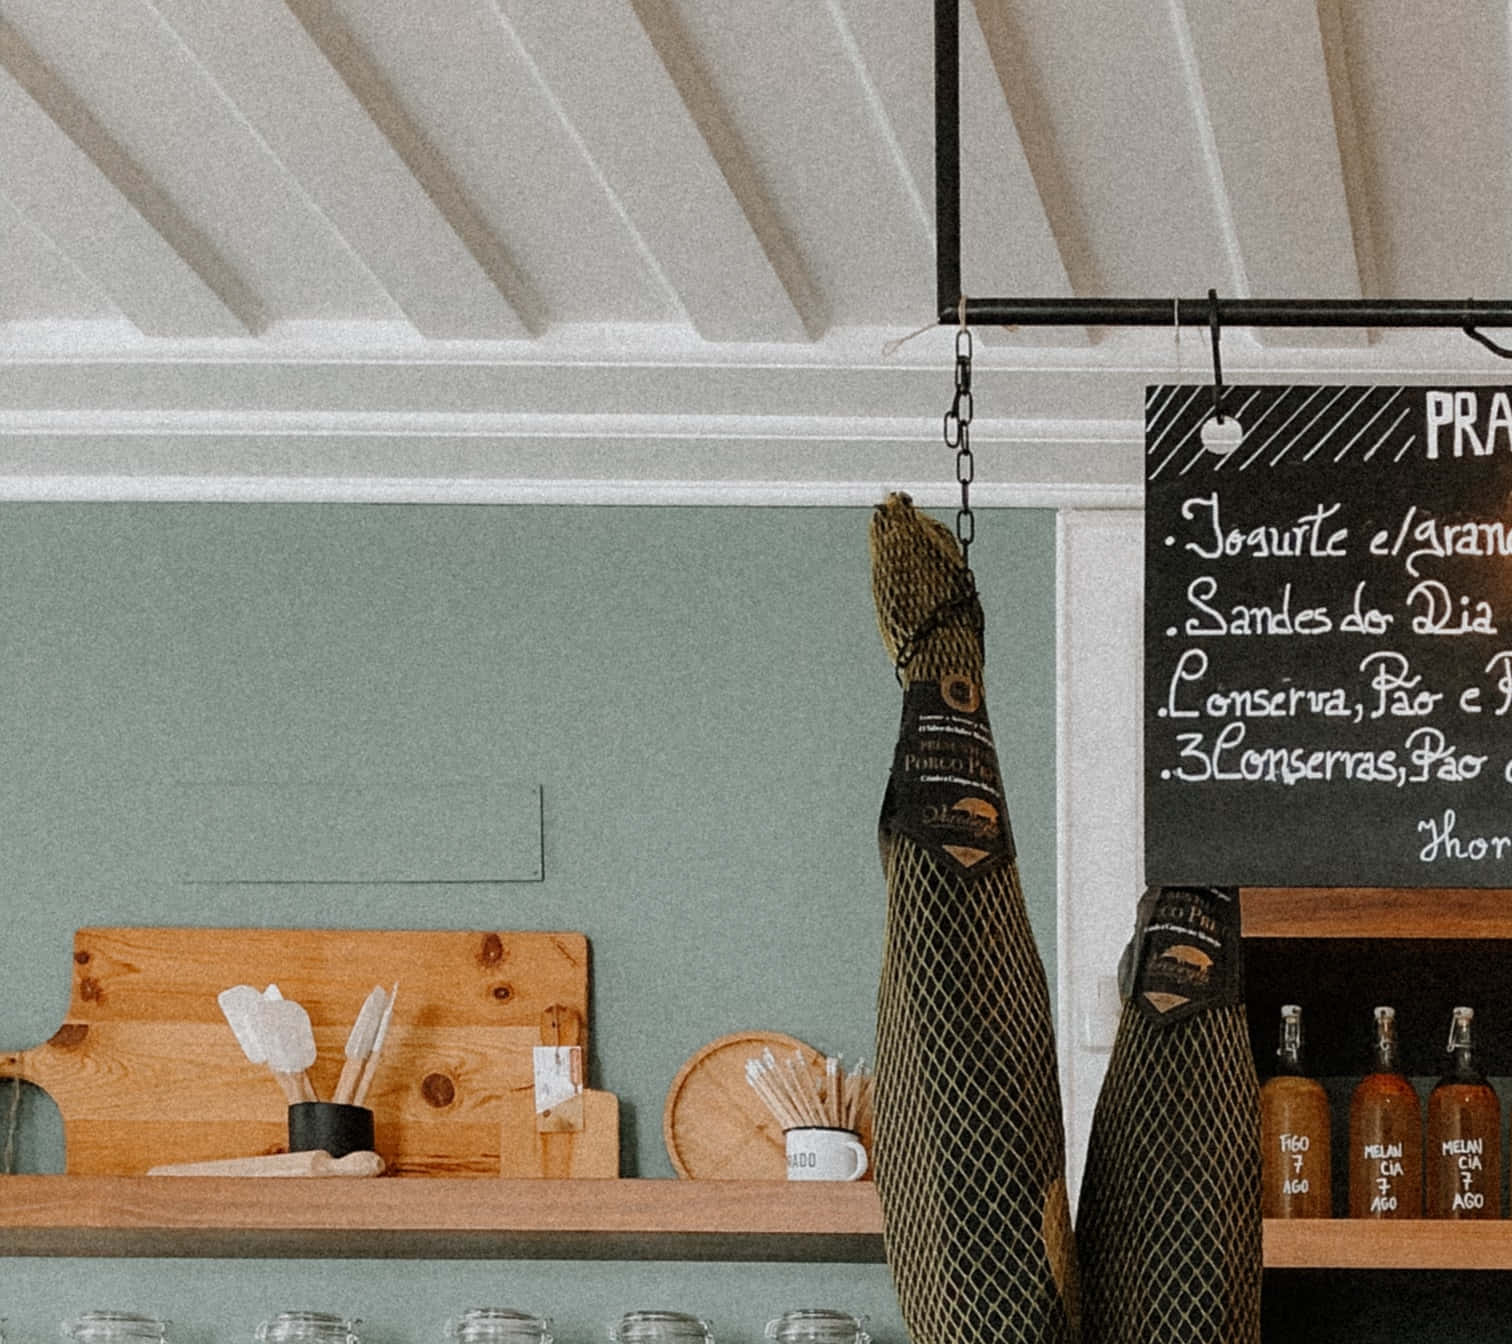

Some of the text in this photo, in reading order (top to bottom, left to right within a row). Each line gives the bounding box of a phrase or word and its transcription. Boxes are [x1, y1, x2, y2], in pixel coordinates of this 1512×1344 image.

[1186, 575, 1498, 636] Sandes do Dia
[1459, 687, 1483, 714] e
[1280, 1133, 1310, 1153] FIGO
[1364, 1141, 1403, 1159] MELAN
[1442, 1137, 1483, 1156] MELAN
[1291, 1154, 1304, 1174] 7
[1283, 1179, 1309, 1195] AGO
[1376, 1177, 1391, 1195] 7
[1460, 1171, 1473, 1191] 7
[1370, 1196, 1398, 1212] AGO
[1452, 1191, 1484, 1210] AGO
